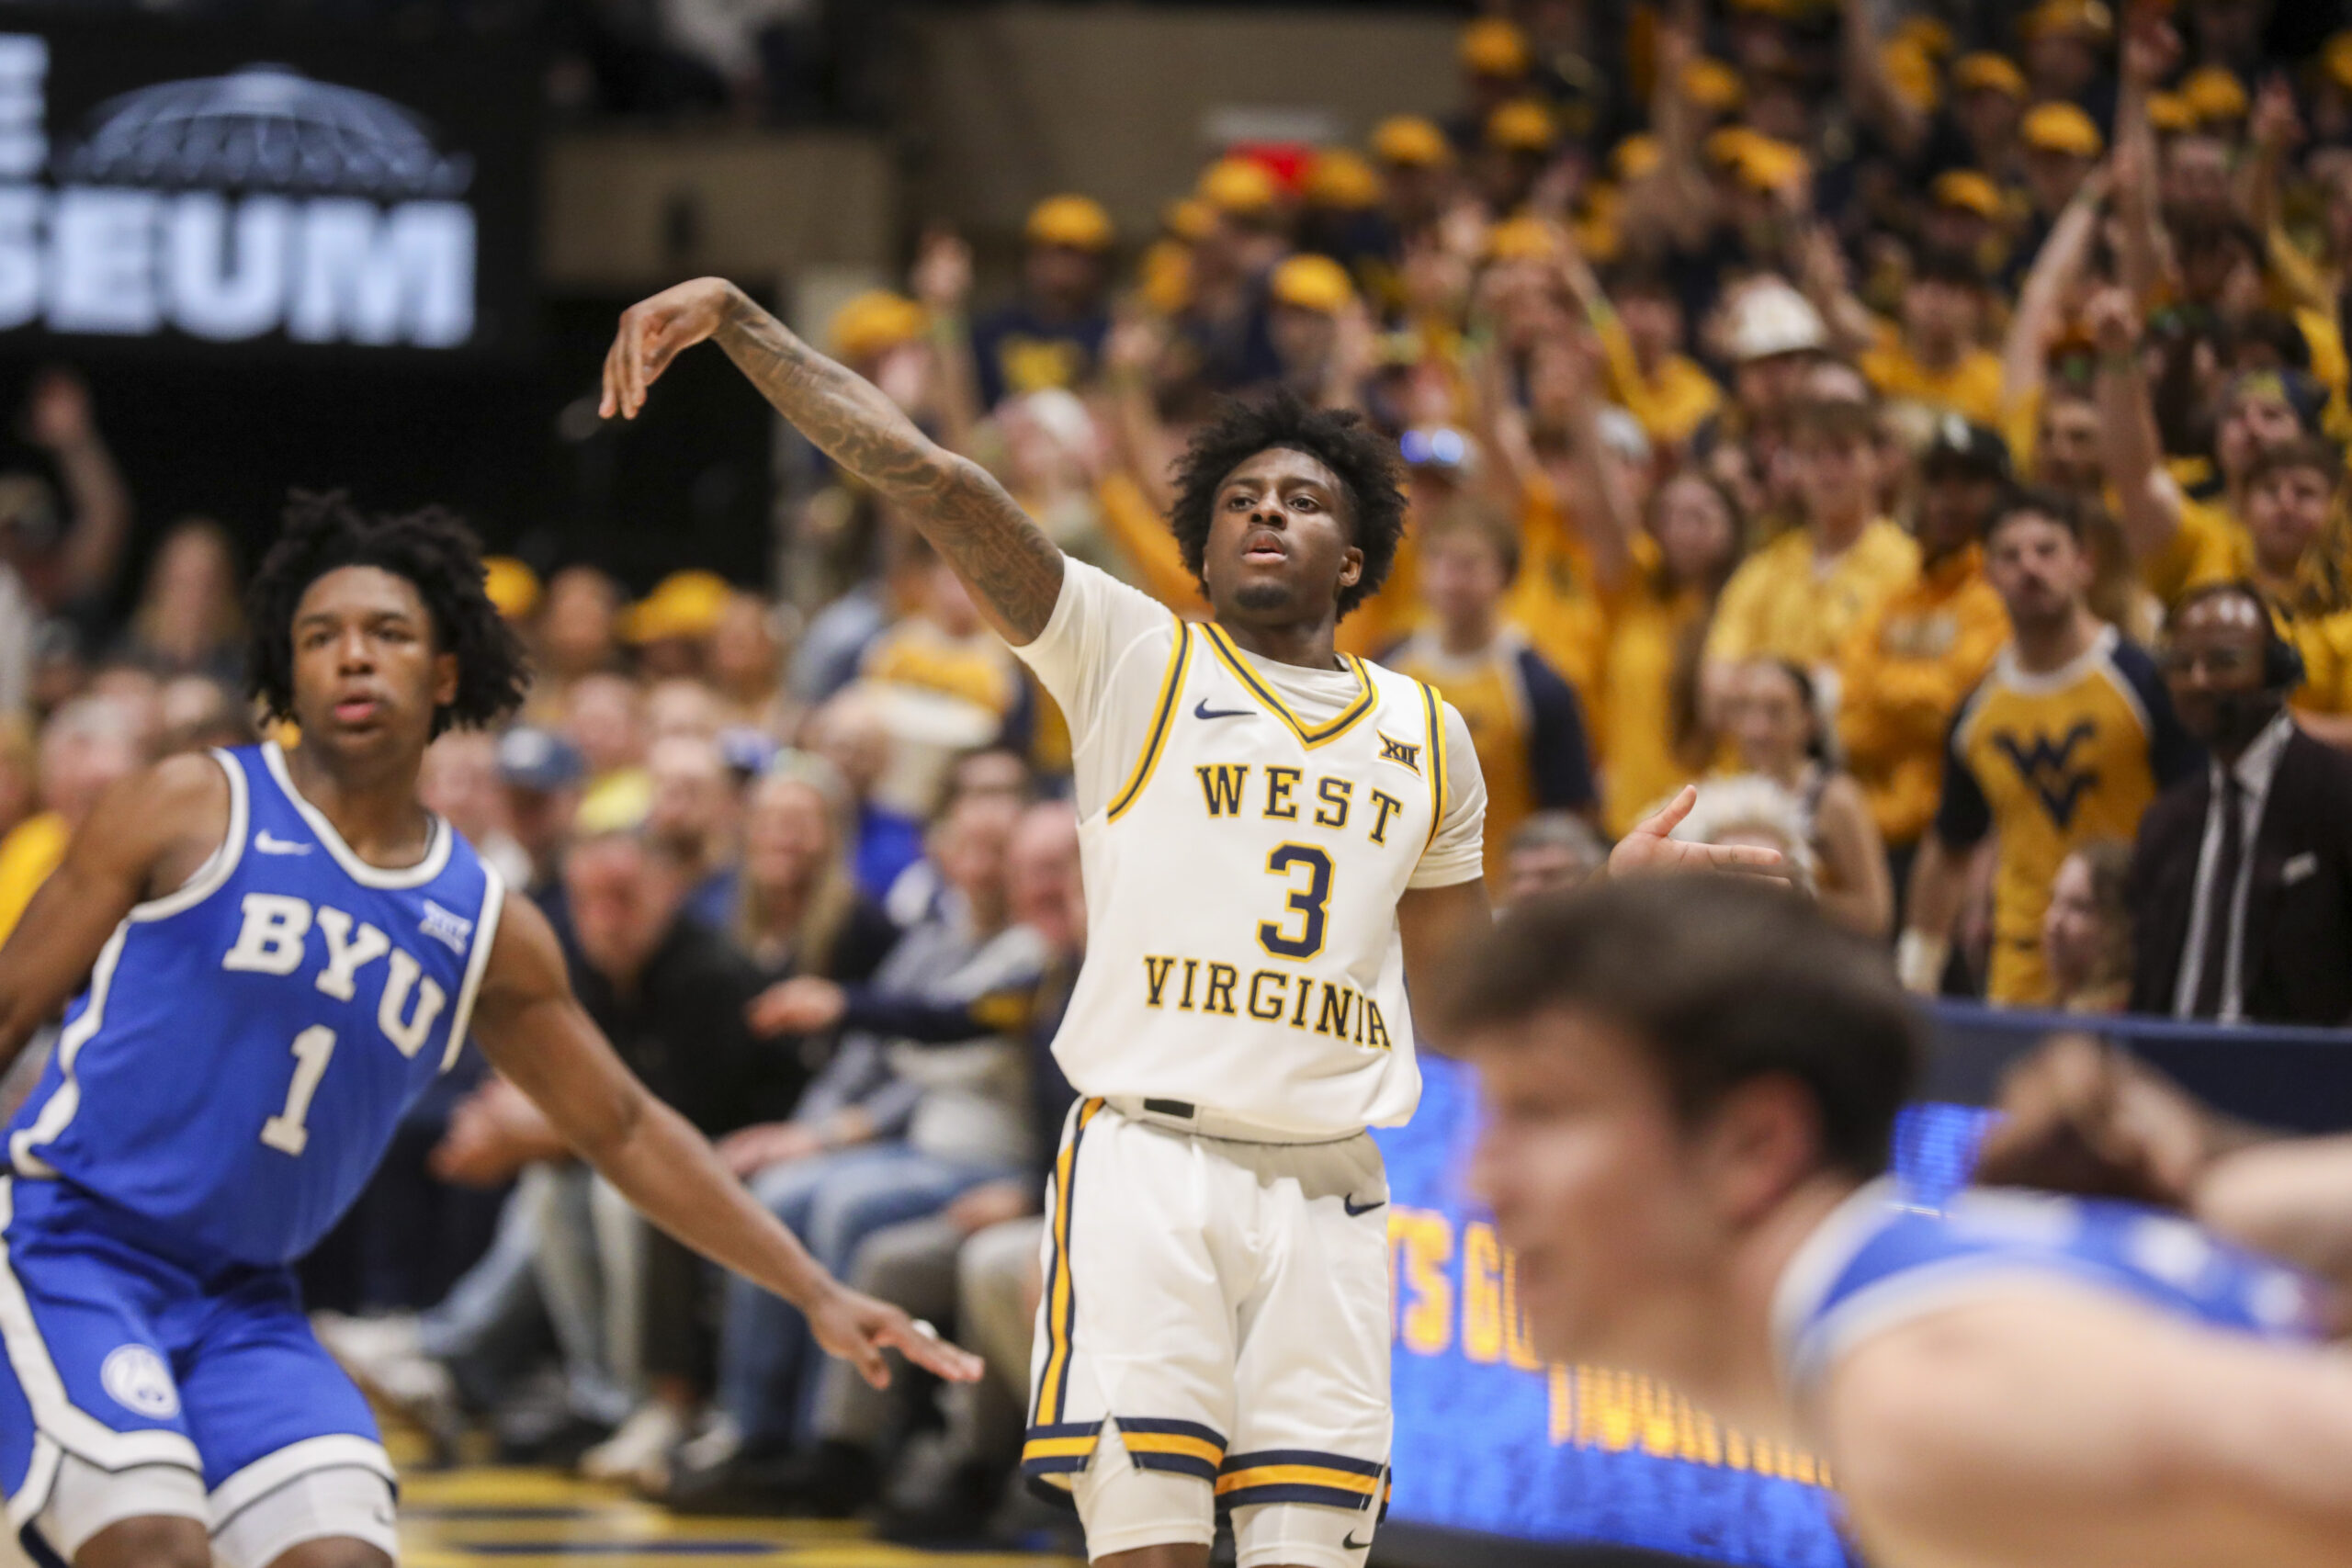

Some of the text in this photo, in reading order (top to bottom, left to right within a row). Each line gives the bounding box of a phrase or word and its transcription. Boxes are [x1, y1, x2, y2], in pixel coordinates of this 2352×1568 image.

[1194, 763, 1403, 847] WEST
[1256, 840, 1336, 963] 3
[222, 892, 447, 1059] BYU
[1143, 954, 1393, 1051] VIRGINIA
[260, 1024, 336, 1156] 1
